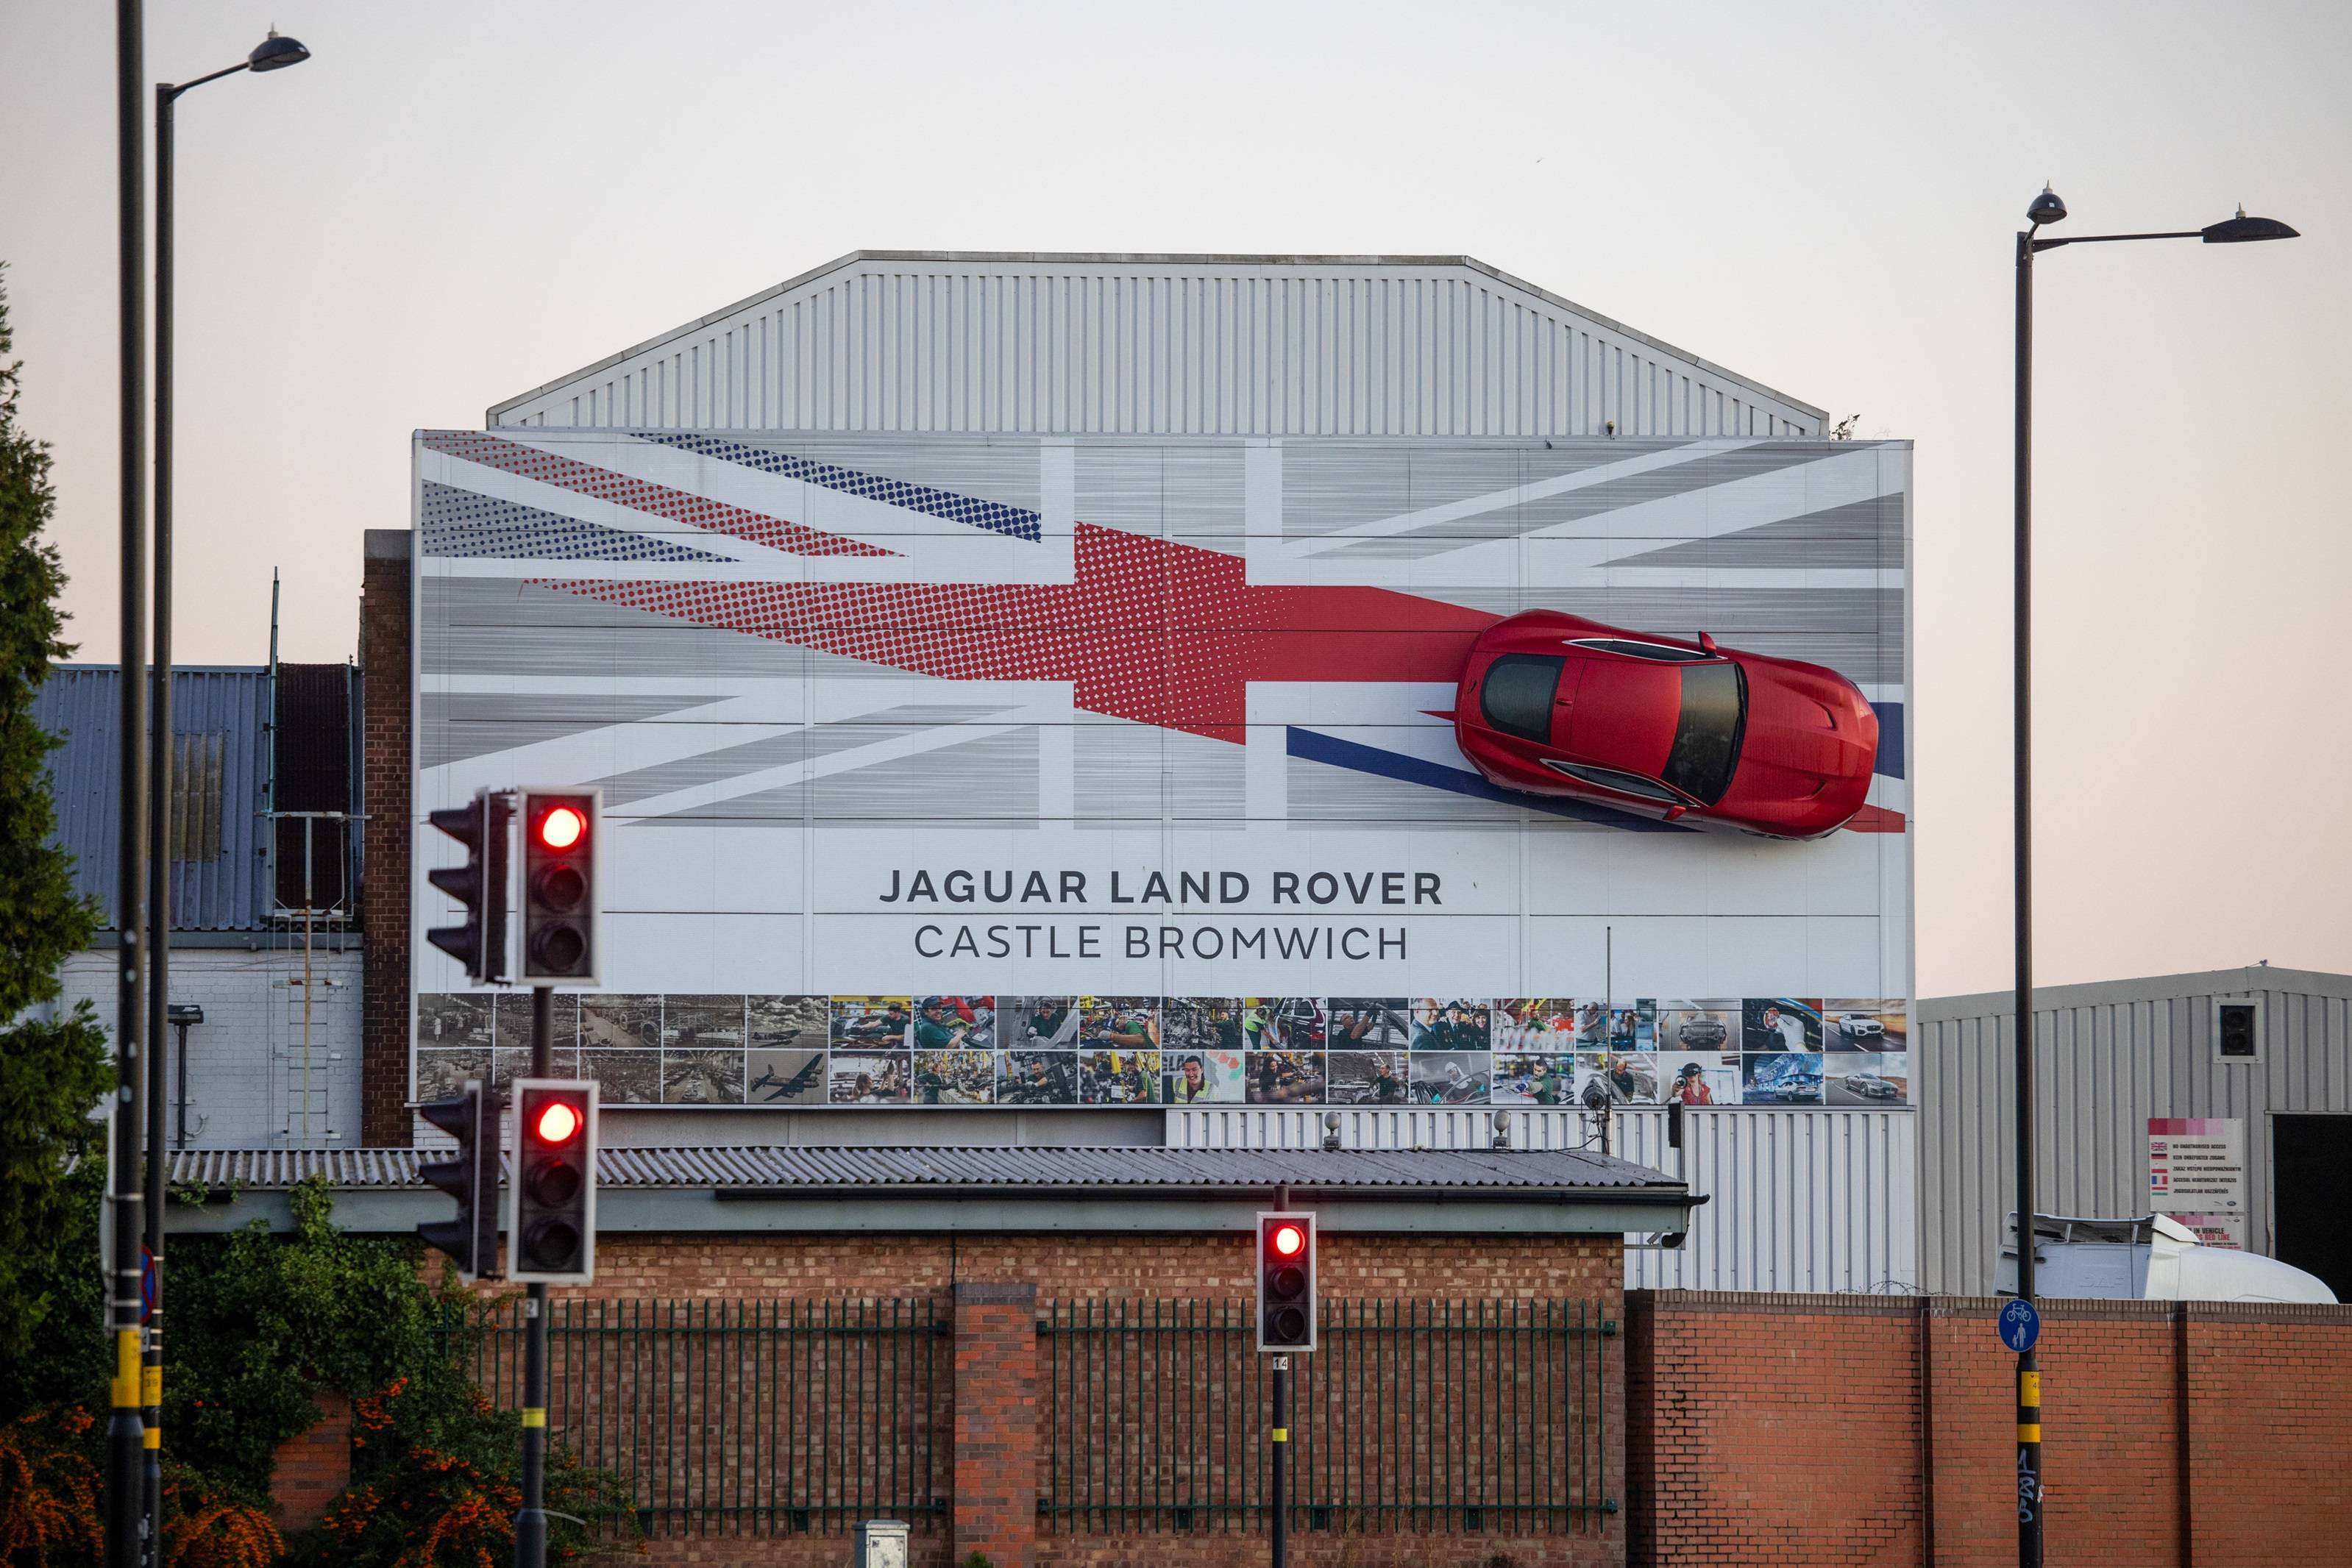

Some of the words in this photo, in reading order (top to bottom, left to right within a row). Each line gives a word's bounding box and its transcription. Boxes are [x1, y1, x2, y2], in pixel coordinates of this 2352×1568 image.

[879, 869, 1087, 903] JAGUAR
[1111, 871, 1249, 904] LAND
[1273, 872, 1441, 905] ROVER
[914, 924, 1101, 958] CASTLE
[1126, 926, 1406, 960] BROMWICH
[1274, 1358, 1287, 1369] 14
